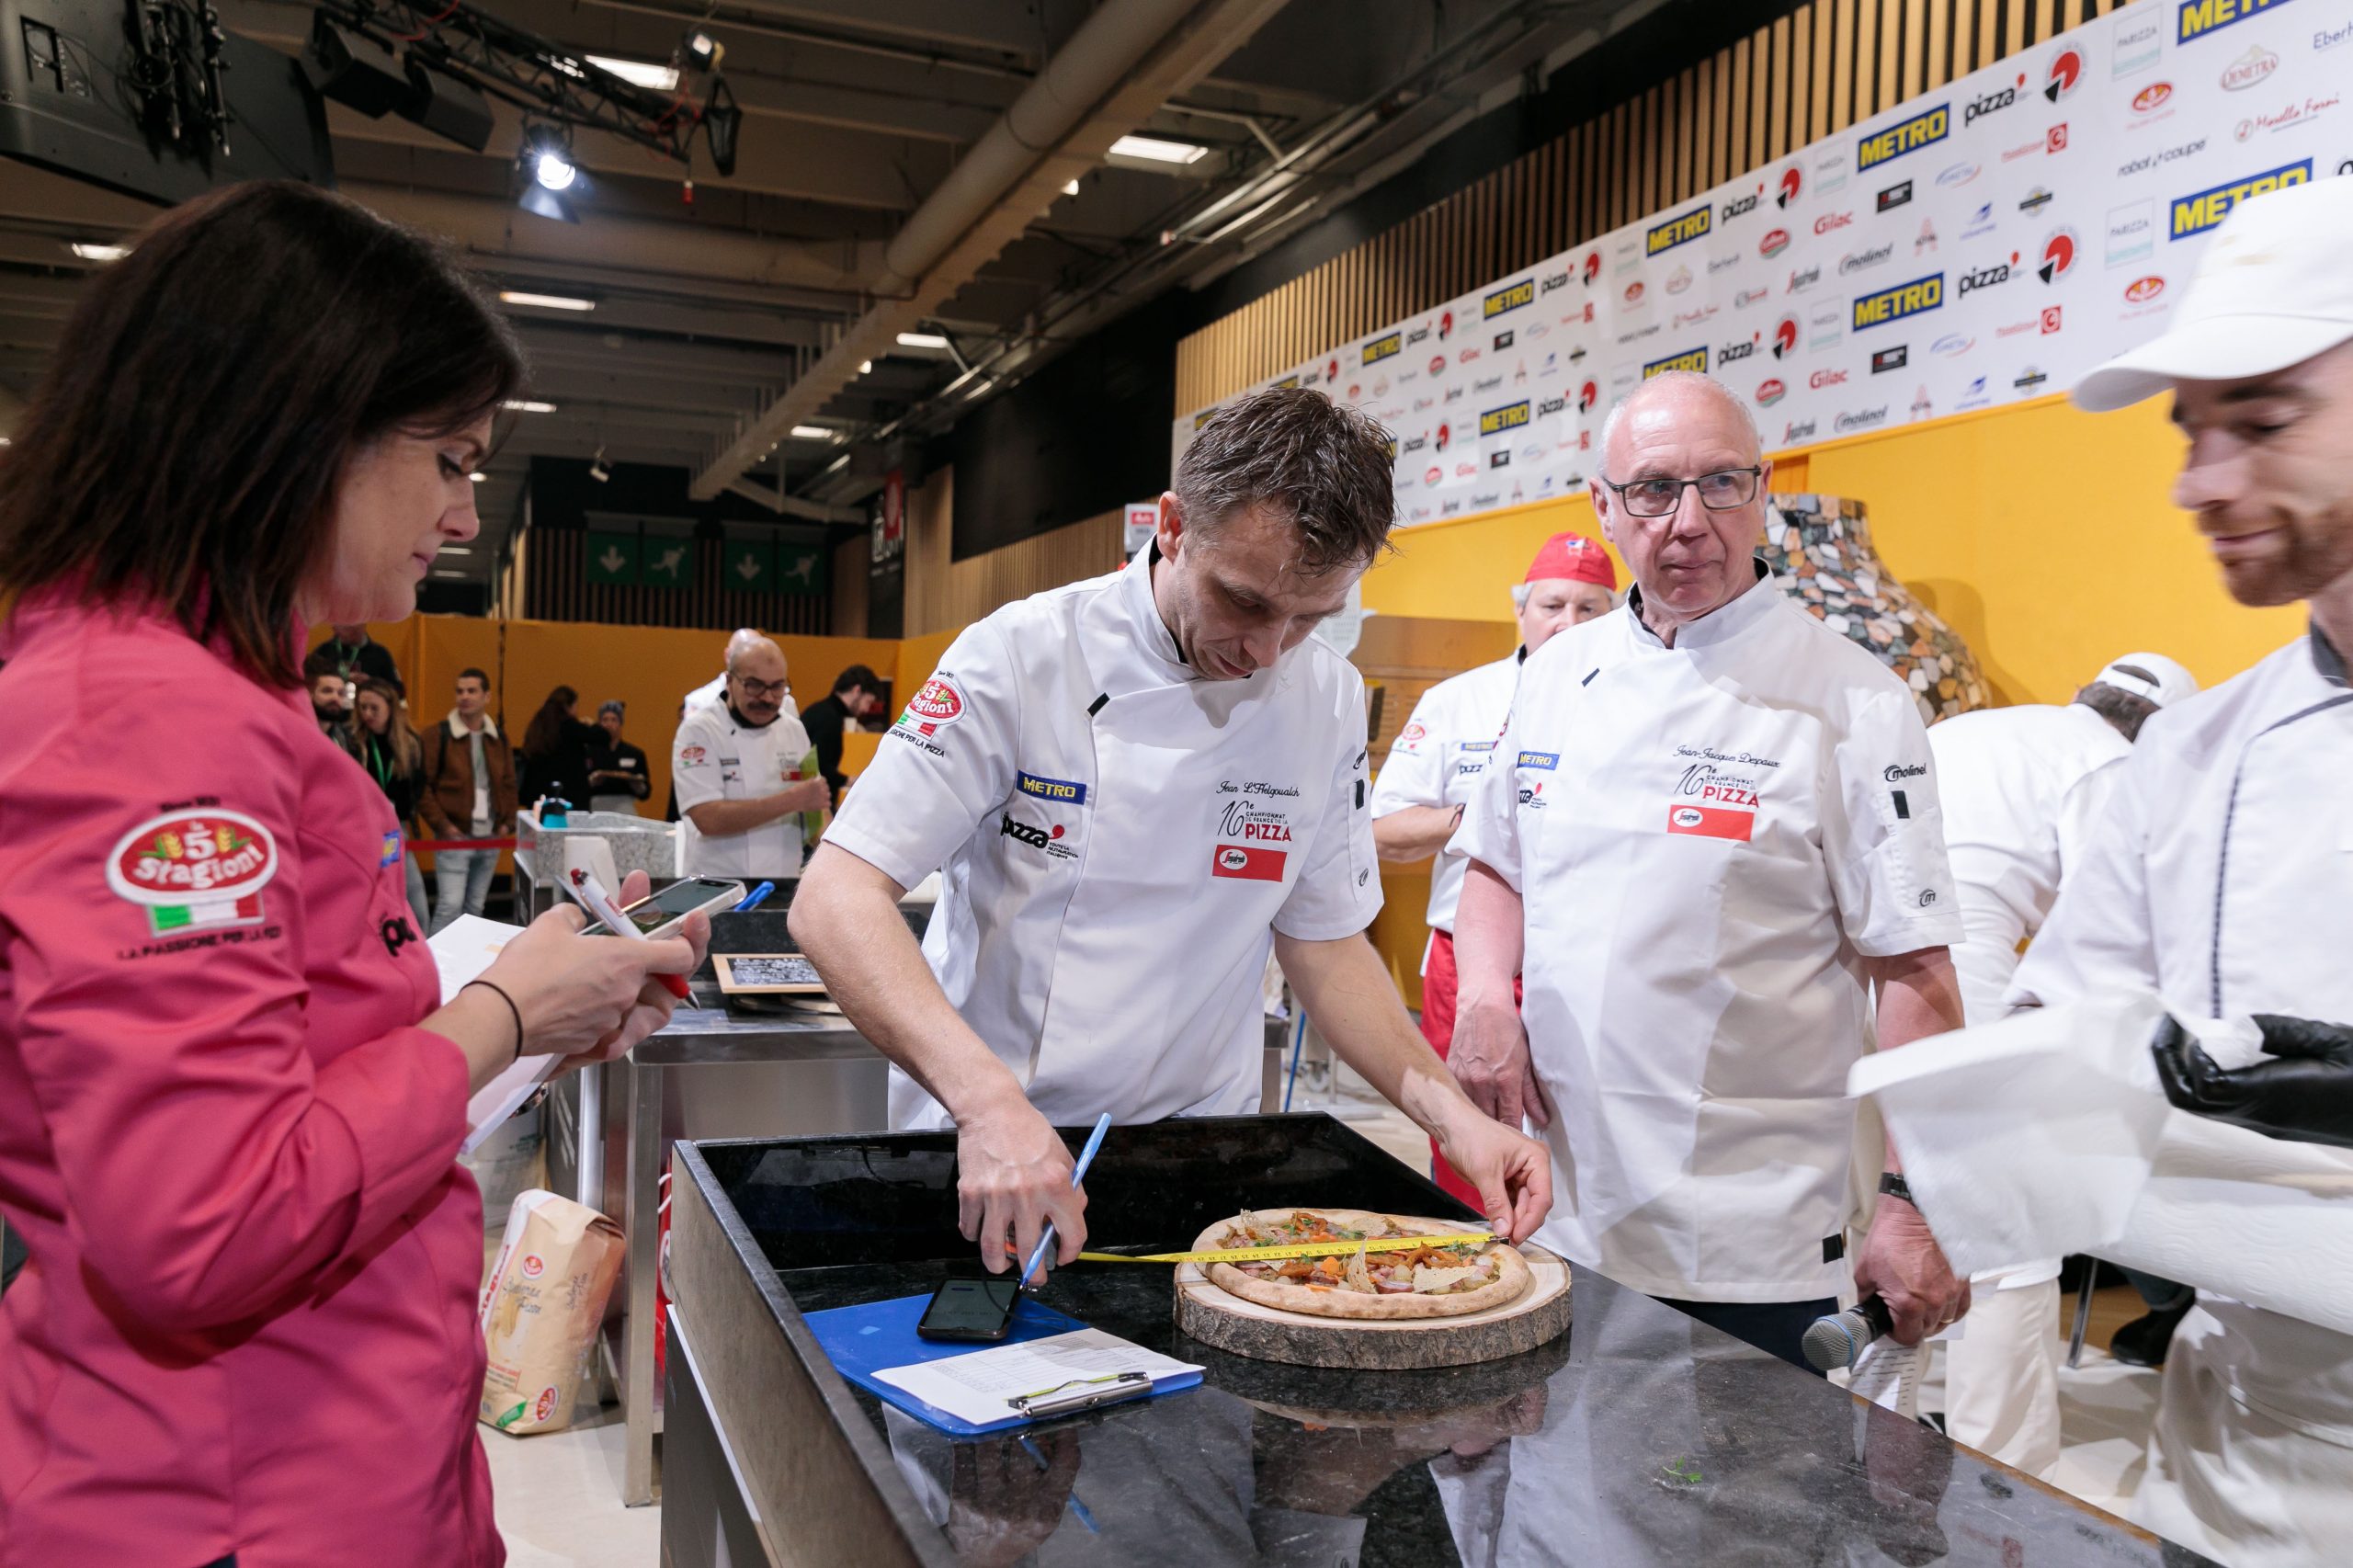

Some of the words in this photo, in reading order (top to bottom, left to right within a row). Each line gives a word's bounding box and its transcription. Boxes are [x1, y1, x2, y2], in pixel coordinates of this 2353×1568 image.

[1965, 85, 2015, 127] pizza
[1859, 111, 1947, 169] METRO
[2118, 158, 2152, 177] robot
[2163, 137, 2207, 163] coupe
[1722, 195, 1756, 226] pizza
[1648, 210, 1709, 253] METRO
[1959, 264, 2010, 299] pizza
[1485, 284, 1532, 318] METRO
[1855, 278, 1941, 327] METRO
[1718, 338, 1754, 368] pizza
[1482, 404, 1529, 434] METRO
[925, 684, 938, 699] 5
[924, 743, 946, 758] PIZZA
[1519, 753, 1552, 766] METRO
[1673, 744, 1736, 762] Jean-Jacques
[1459, 764, 1483, 776] pizz
[1023, 777, 1076, 798] METRO
[1215, 780, 1239, 794] Jean
[1702, 786, 1759, 809] PIZZA
[1245, 811, 1286, 819] CHAMPIONNAT
[185, 829, 216, 859] 5
[1245, 824, 1292, 842] PIZZA
[133, 842, 265, 890] Stagioni
